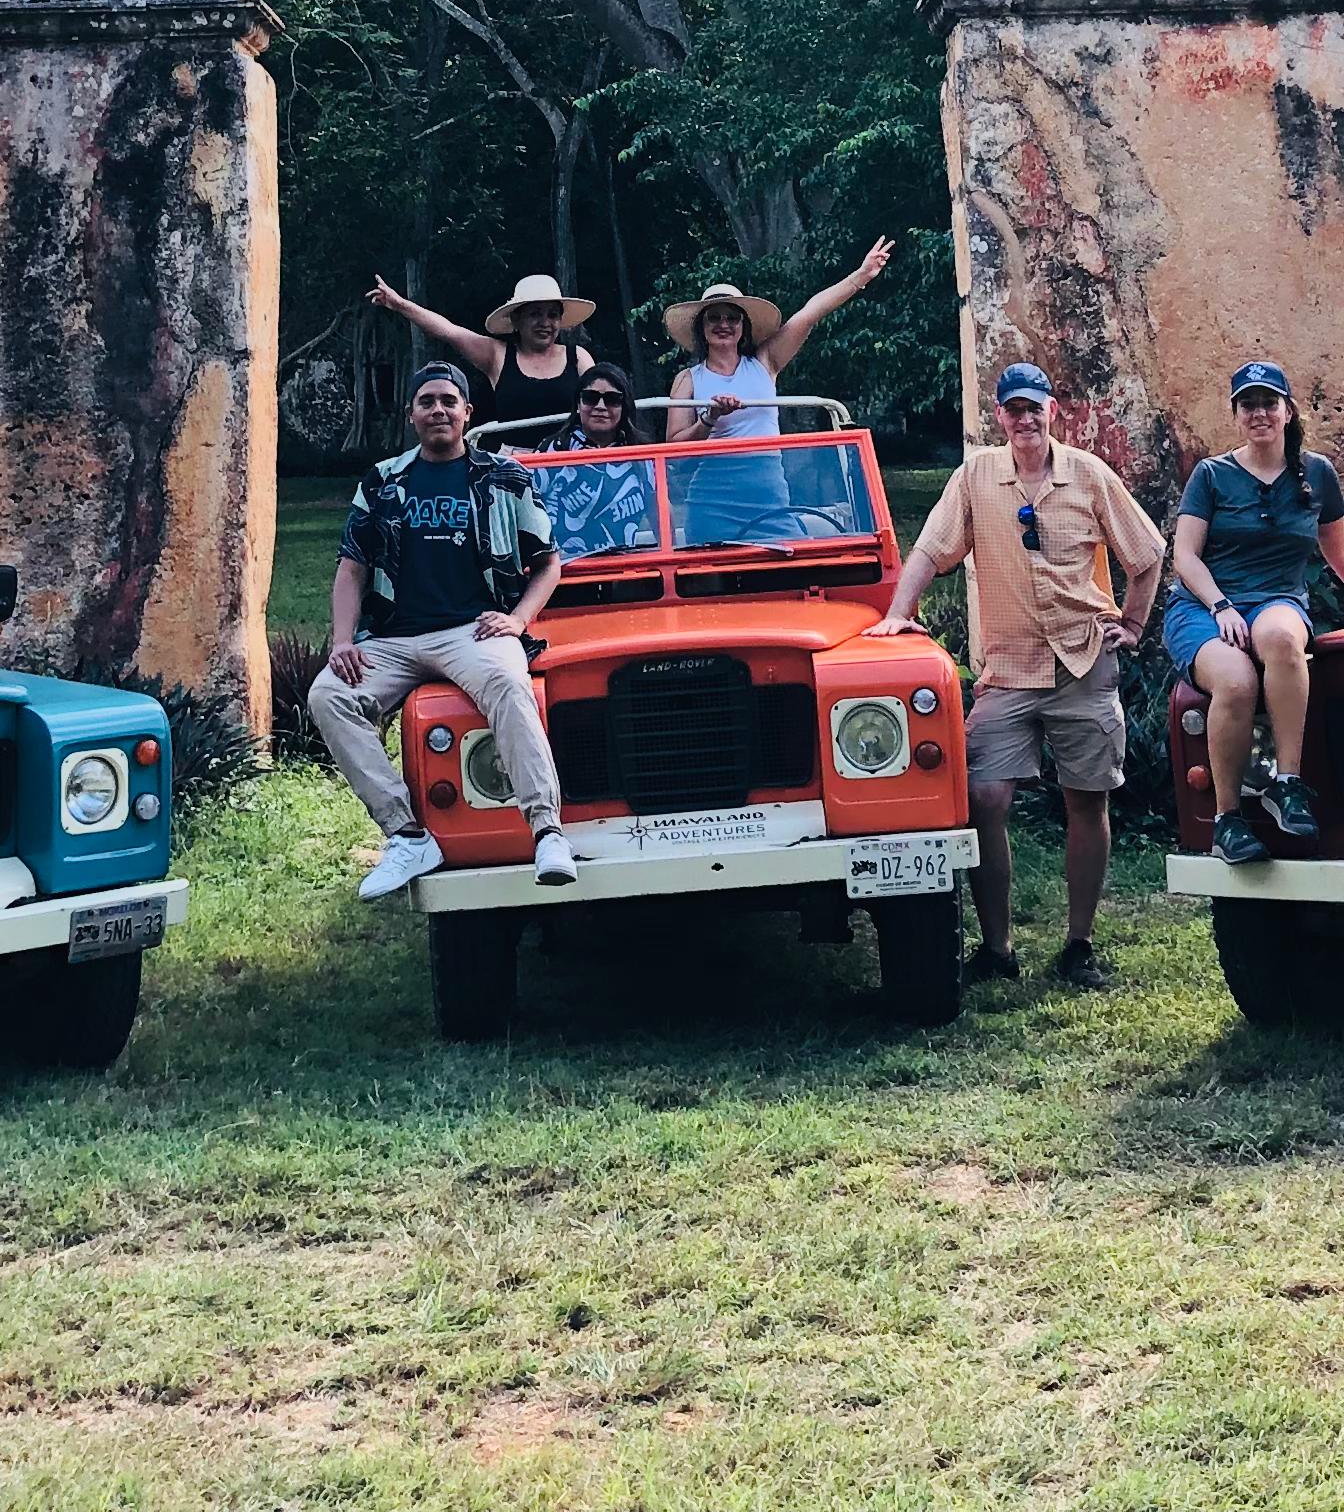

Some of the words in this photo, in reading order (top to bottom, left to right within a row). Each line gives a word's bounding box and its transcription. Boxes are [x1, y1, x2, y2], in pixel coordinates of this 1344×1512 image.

[560, 480, 595, 513] NIKE
[612, 492, 645, 522] NIKE
[658, 823, 765, 841] ADVENTURES
[881, 854, 946, 879] DZ-962
